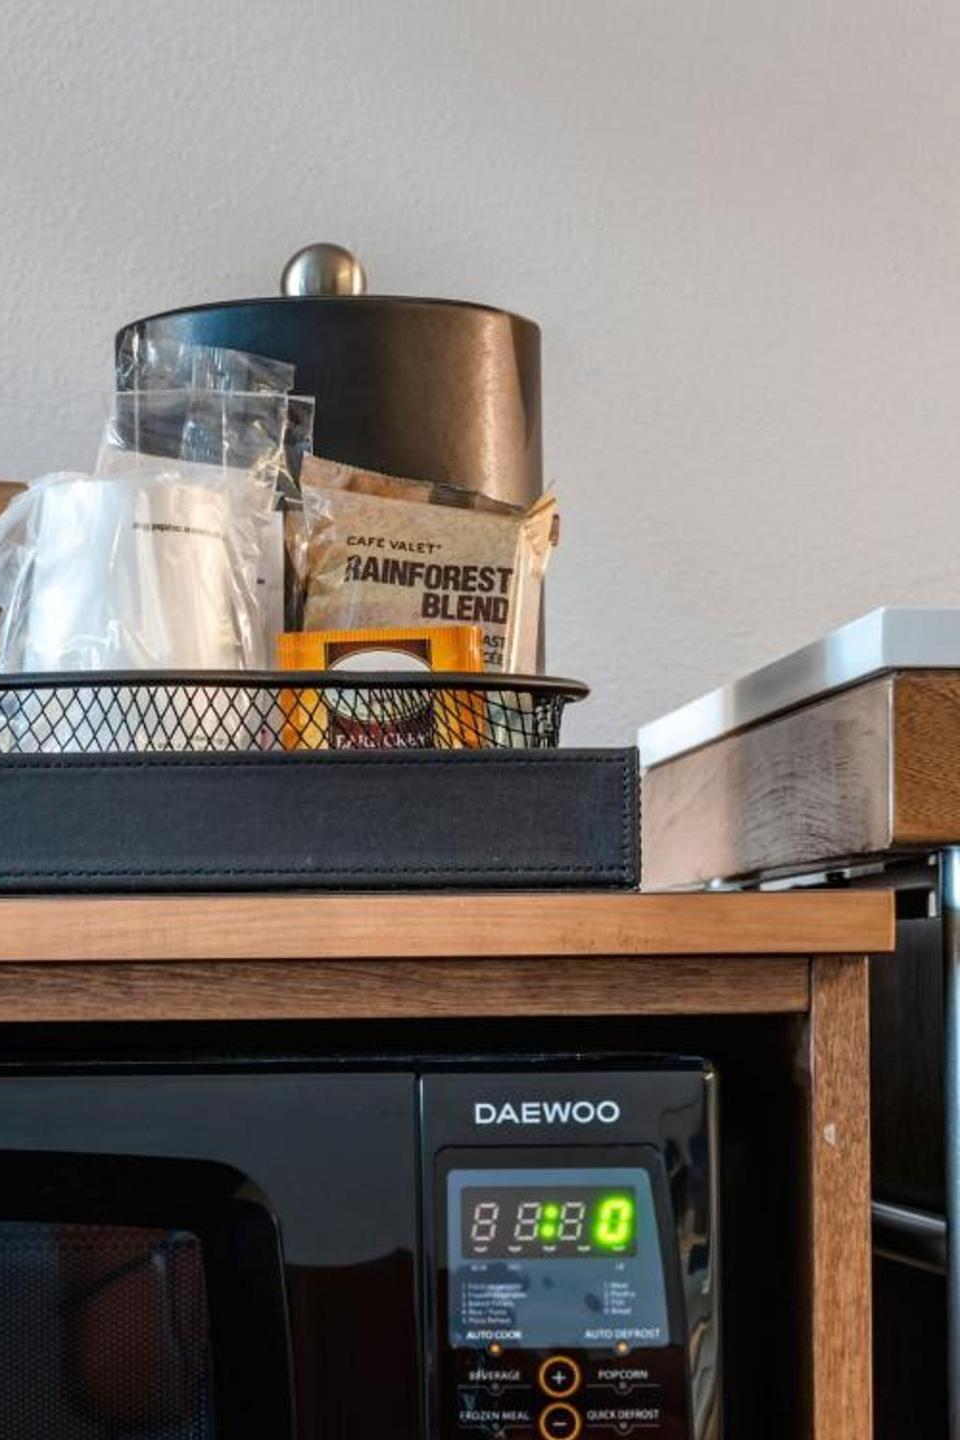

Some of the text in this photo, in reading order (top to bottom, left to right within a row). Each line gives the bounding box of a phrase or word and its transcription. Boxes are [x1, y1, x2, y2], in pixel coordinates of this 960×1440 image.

[344, 555, 513, 593] RAINFOREST
[421, 592, 509, 624] BLEND
[474, 1101, 621, 1124] DAEWOO
[466, 1330, 522, 1340] AUTO COOK
[585, 1327, 660, 1339] AUTO DEFROST
[469, 1370, 520, 1381] BEVERAGE
[598, 1370, 648, 1380] POPCORN
[459, 1410, 529, 1420] FROZEN MEAL
[587, 1409, 659, 1420] QUICK DEFROST
